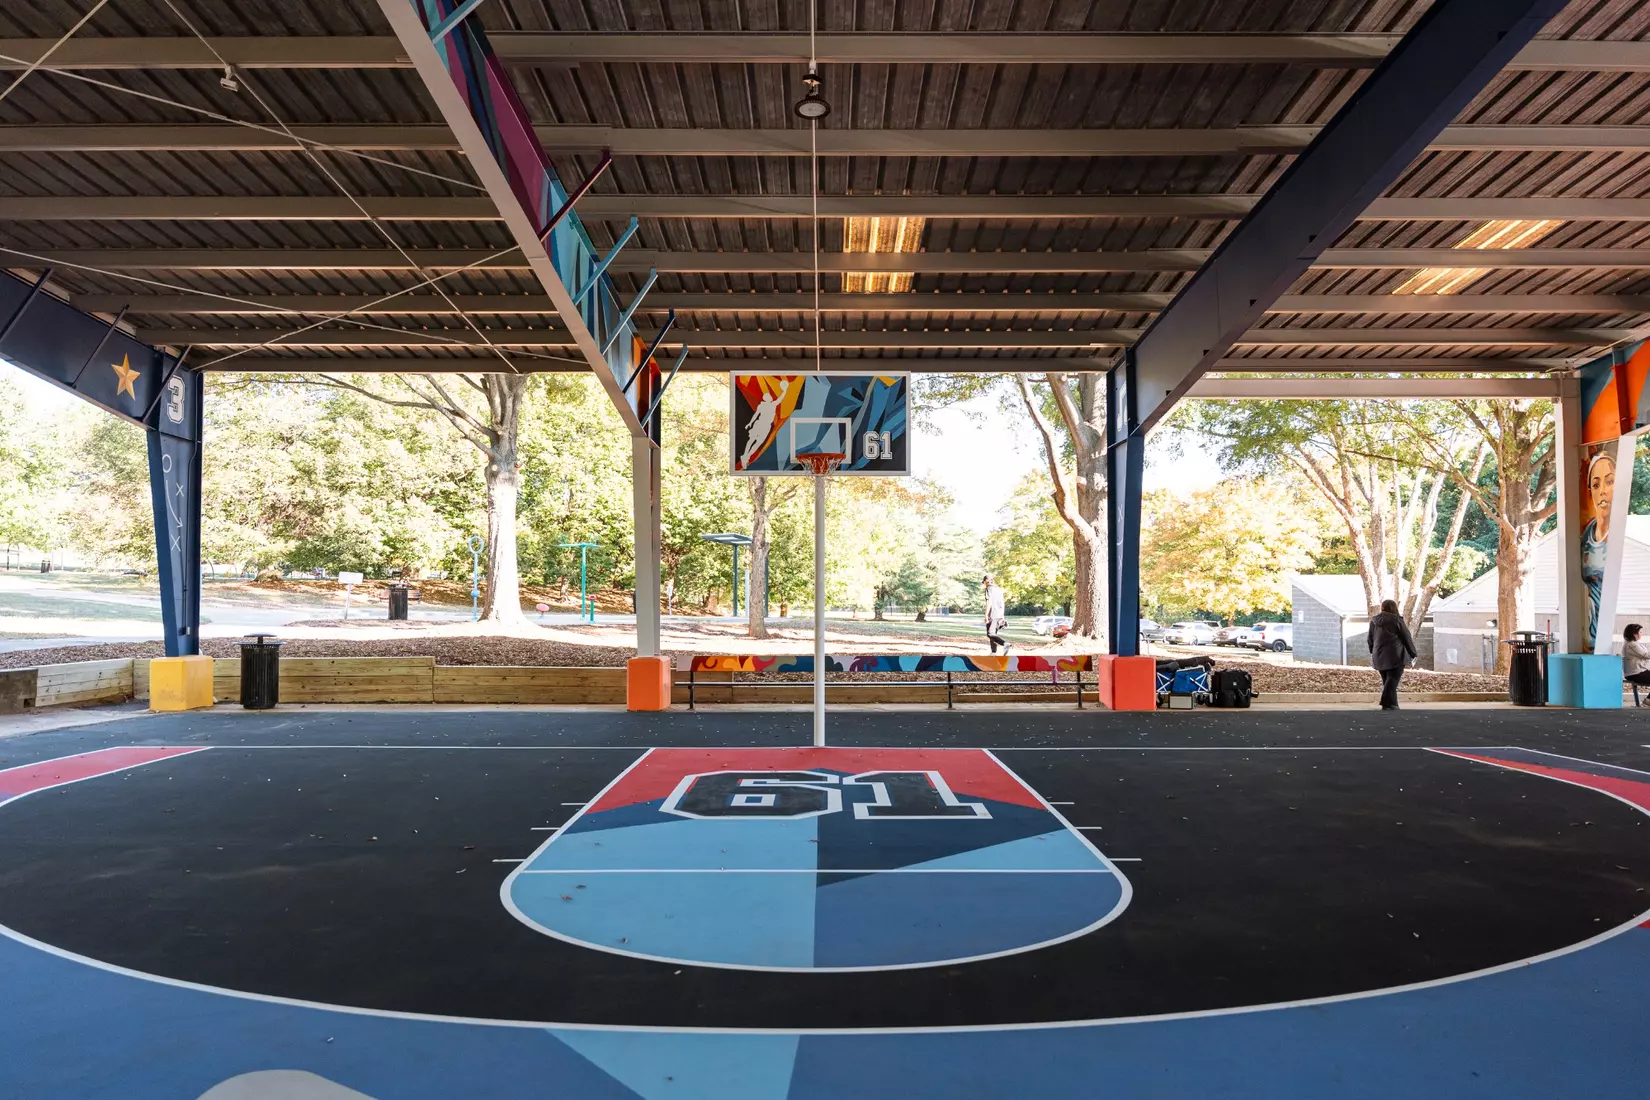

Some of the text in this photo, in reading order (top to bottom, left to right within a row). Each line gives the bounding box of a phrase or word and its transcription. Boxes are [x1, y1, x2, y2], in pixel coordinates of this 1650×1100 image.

[166, 374, 186, 425] 3
[862, 430, 893, 460] 61
[658, 770, 993, 820] 61
